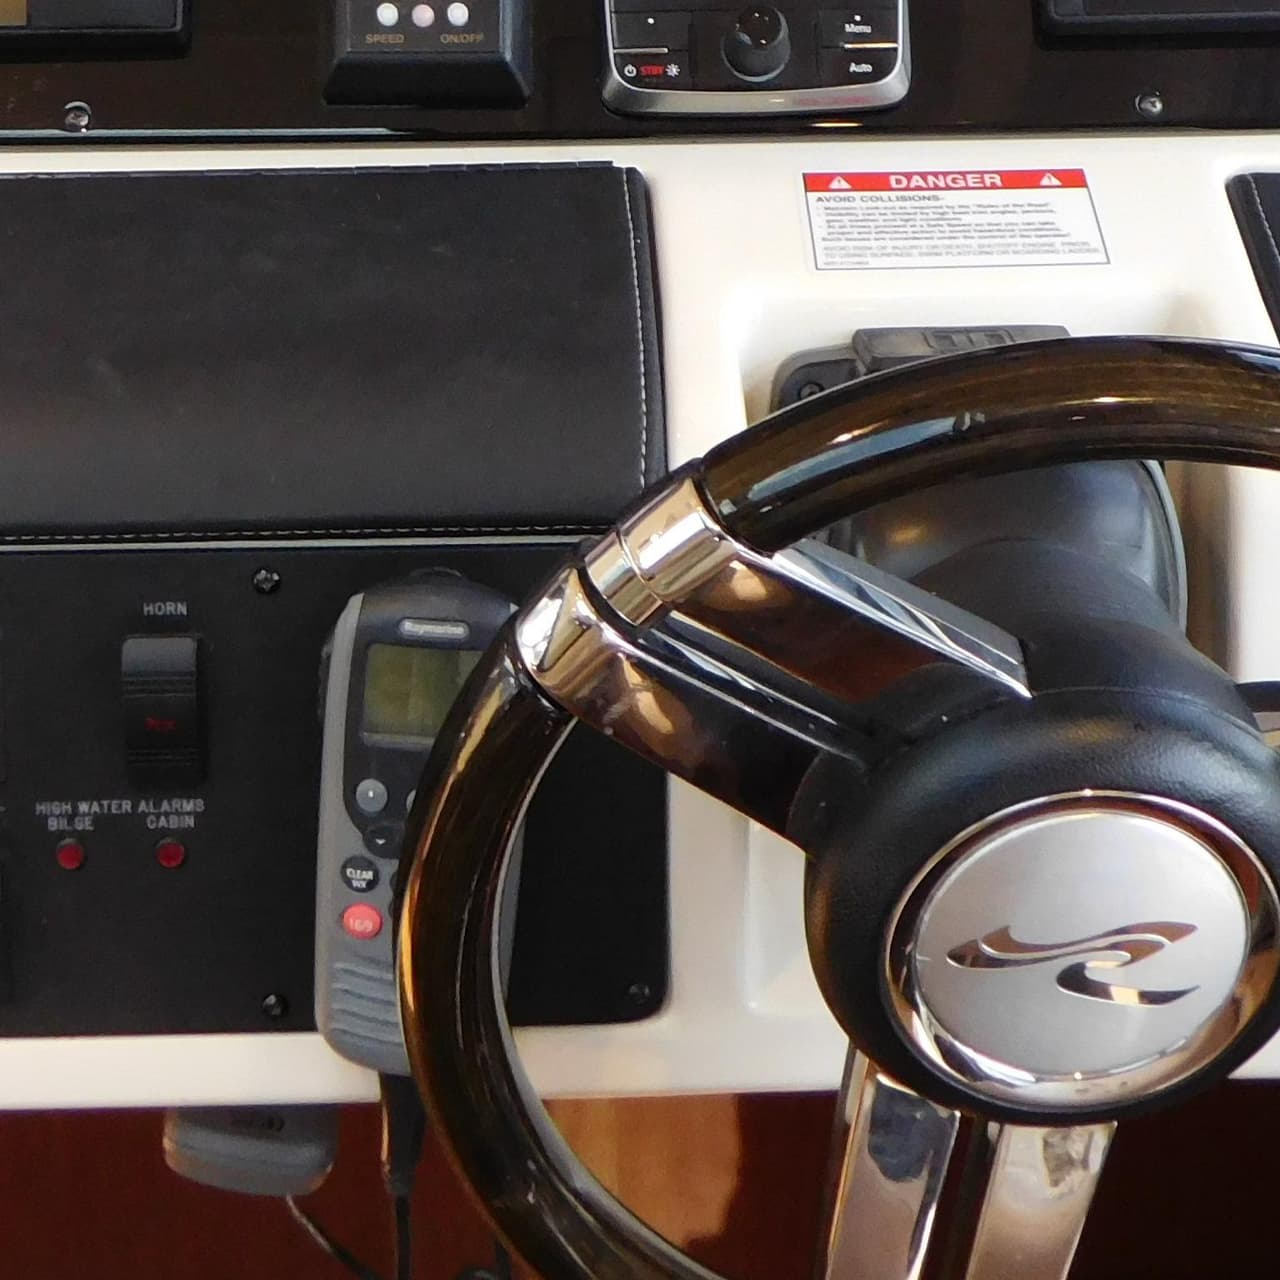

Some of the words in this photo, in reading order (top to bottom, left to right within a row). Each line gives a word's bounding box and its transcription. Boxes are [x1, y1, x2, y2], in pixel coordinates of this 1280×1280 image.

[366, 33, 405, 44] SPEED
[849, 62, 873, 73] Auto
[889, 173, 1003, 189] DANGER
[816, 195, 856, 203] AVOID
[143, 601, 188, 617] HORN
[35, 800, 72, 816] HIGH
[75, 799, 132, 816] WATER
[138, 798, 205, 815] ALARMS
[47, 815, 95, 832] BILGE
[146, 813, 195, 830] CABIN
